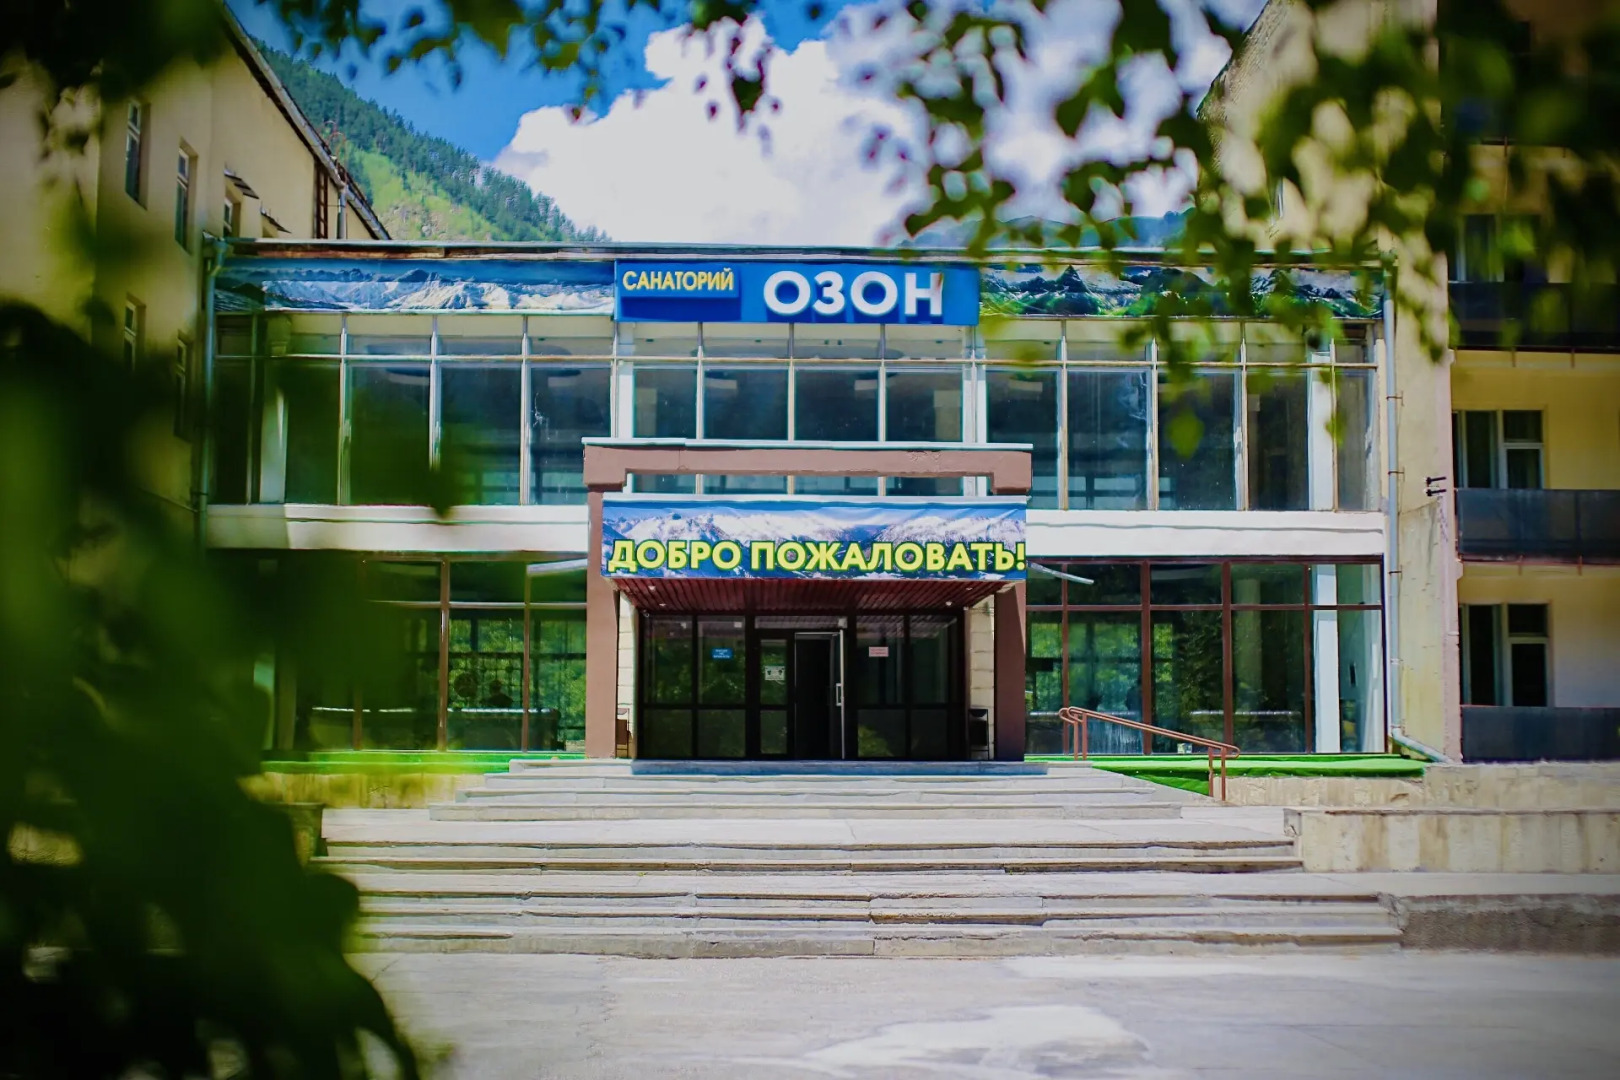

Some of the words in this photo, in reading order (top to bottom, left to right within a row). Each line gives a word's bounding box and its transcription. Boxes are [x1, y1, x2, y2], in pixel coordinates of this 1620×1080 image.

[622, 267, 734, 291] САНАТОРИЙ
[763, 270, 944, 316] ОЗОН
[607, 539, 742, 573] ДОБРО
[749, 540, 1027, 572] ПОЖАЛОВАТЬ!
